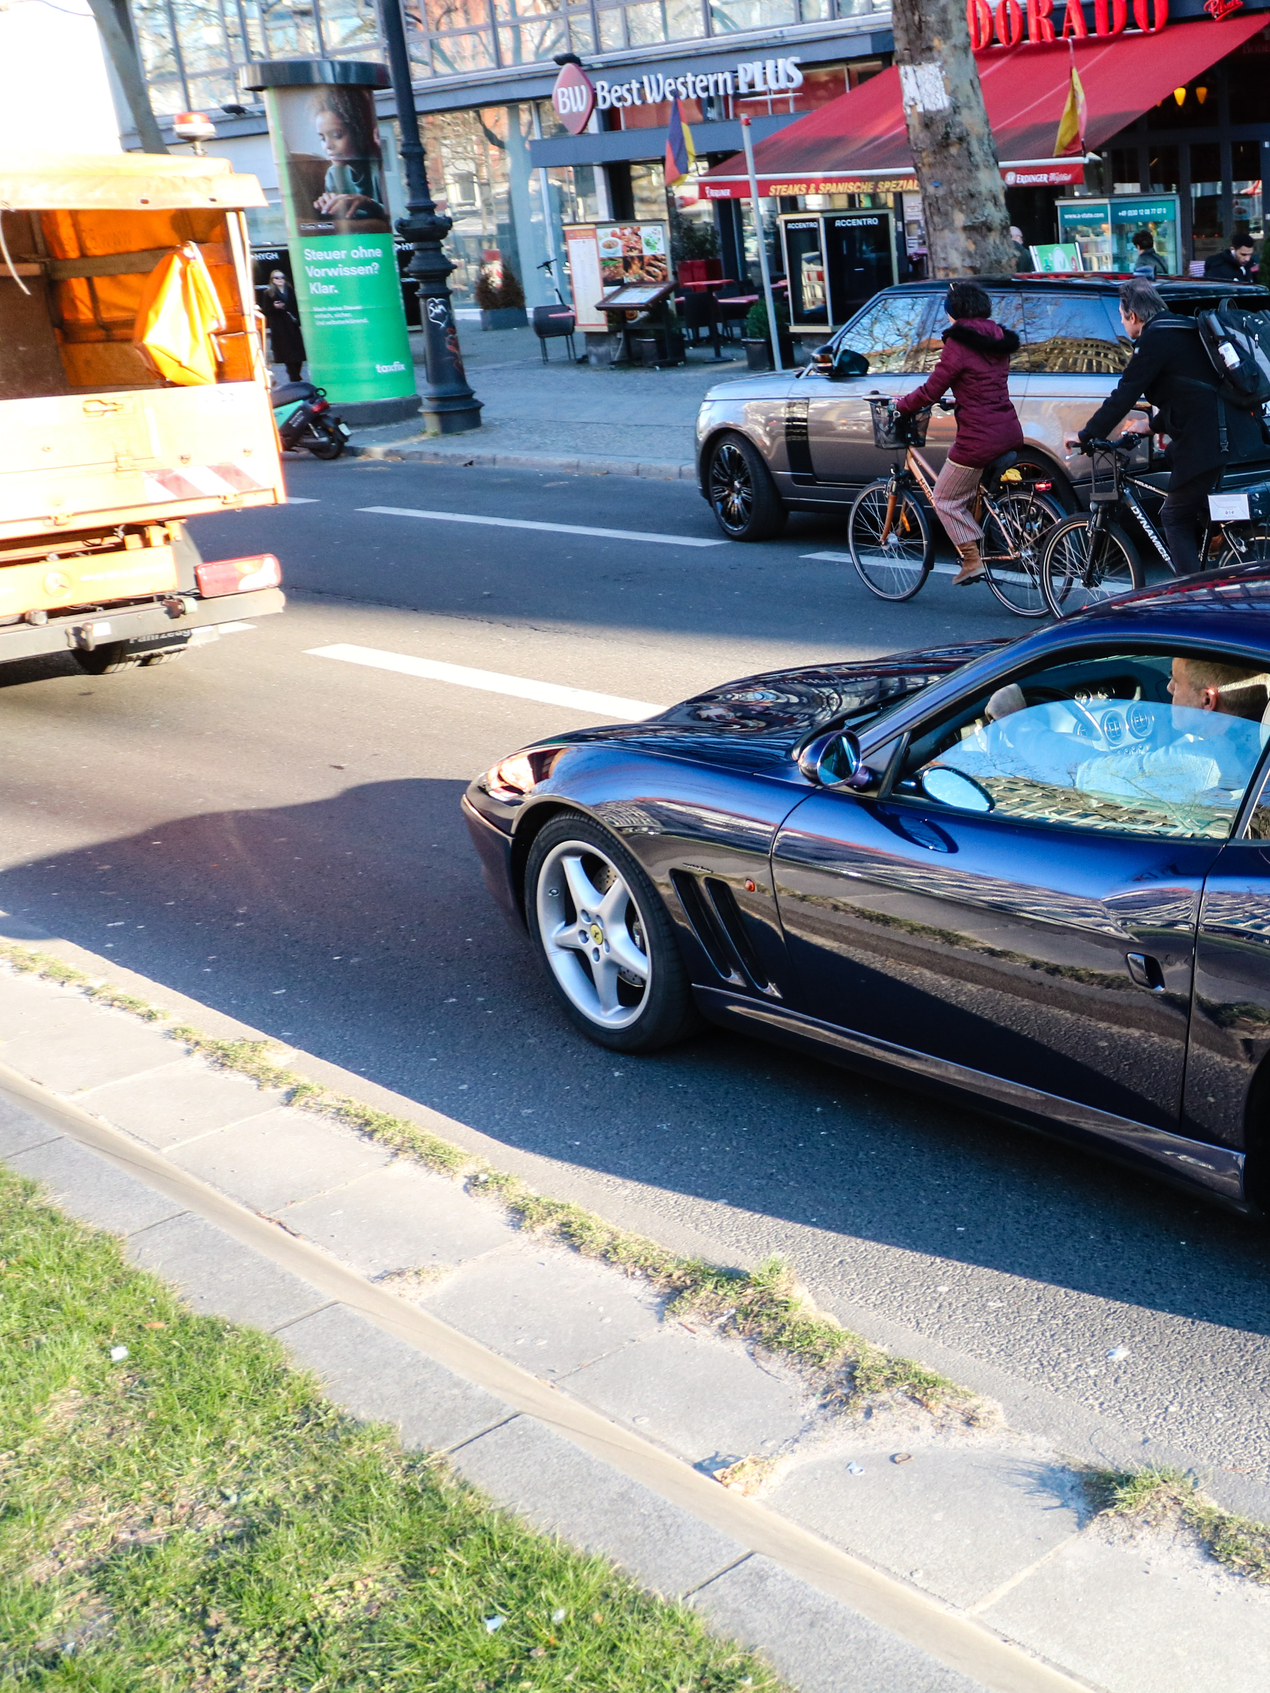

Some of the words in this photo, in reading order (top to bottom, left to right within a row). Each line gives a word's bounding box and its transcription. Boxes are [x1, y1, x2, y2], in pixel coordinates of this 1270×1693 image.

[966, 0, 1169, 50] DORADO
[596, 79, 641, 110] Best
[642, 70, 734, 104] Western
[737, 56, 804, 94] PLUS
[556, 84, 588, 114] BW
[1016, 173, 1048, 184] ERDINGER
[769, 183, 807, 196] STEAKS
[809, 183, 816, 194] &
[819, 181, 874, 194] SPANISCHE
[876, 179, 920, 192] SPEZIAL
[834, 217, 879, 227] ACCENTRO
[303, 248, 347, 261] Steuer
[350, 245, 383, 259] ohne
[304, 262, 380, 278] Vorwissen?
[309, 282, 339, 295] Klar.
[375, 361, 406, 374] taxfix
